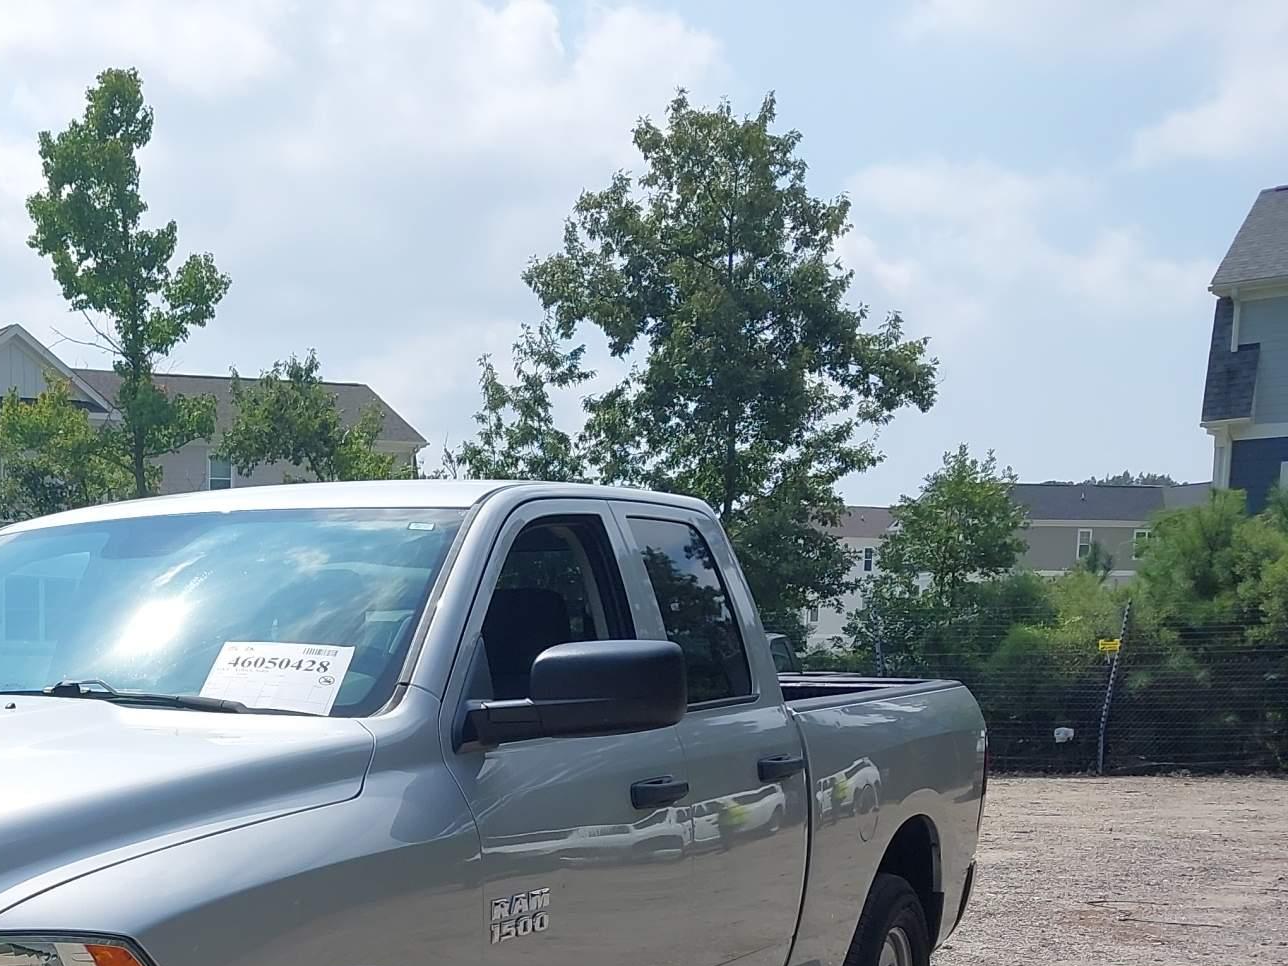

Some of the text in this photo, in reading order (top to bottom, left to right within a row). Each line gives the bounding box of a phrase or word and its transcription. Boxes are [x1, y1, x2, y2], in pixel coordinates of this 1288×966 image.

[228, 655, 331, 674] 46050428
[491, 887, 550, 921] RAM
[491, 911, 549, 944] 1500
